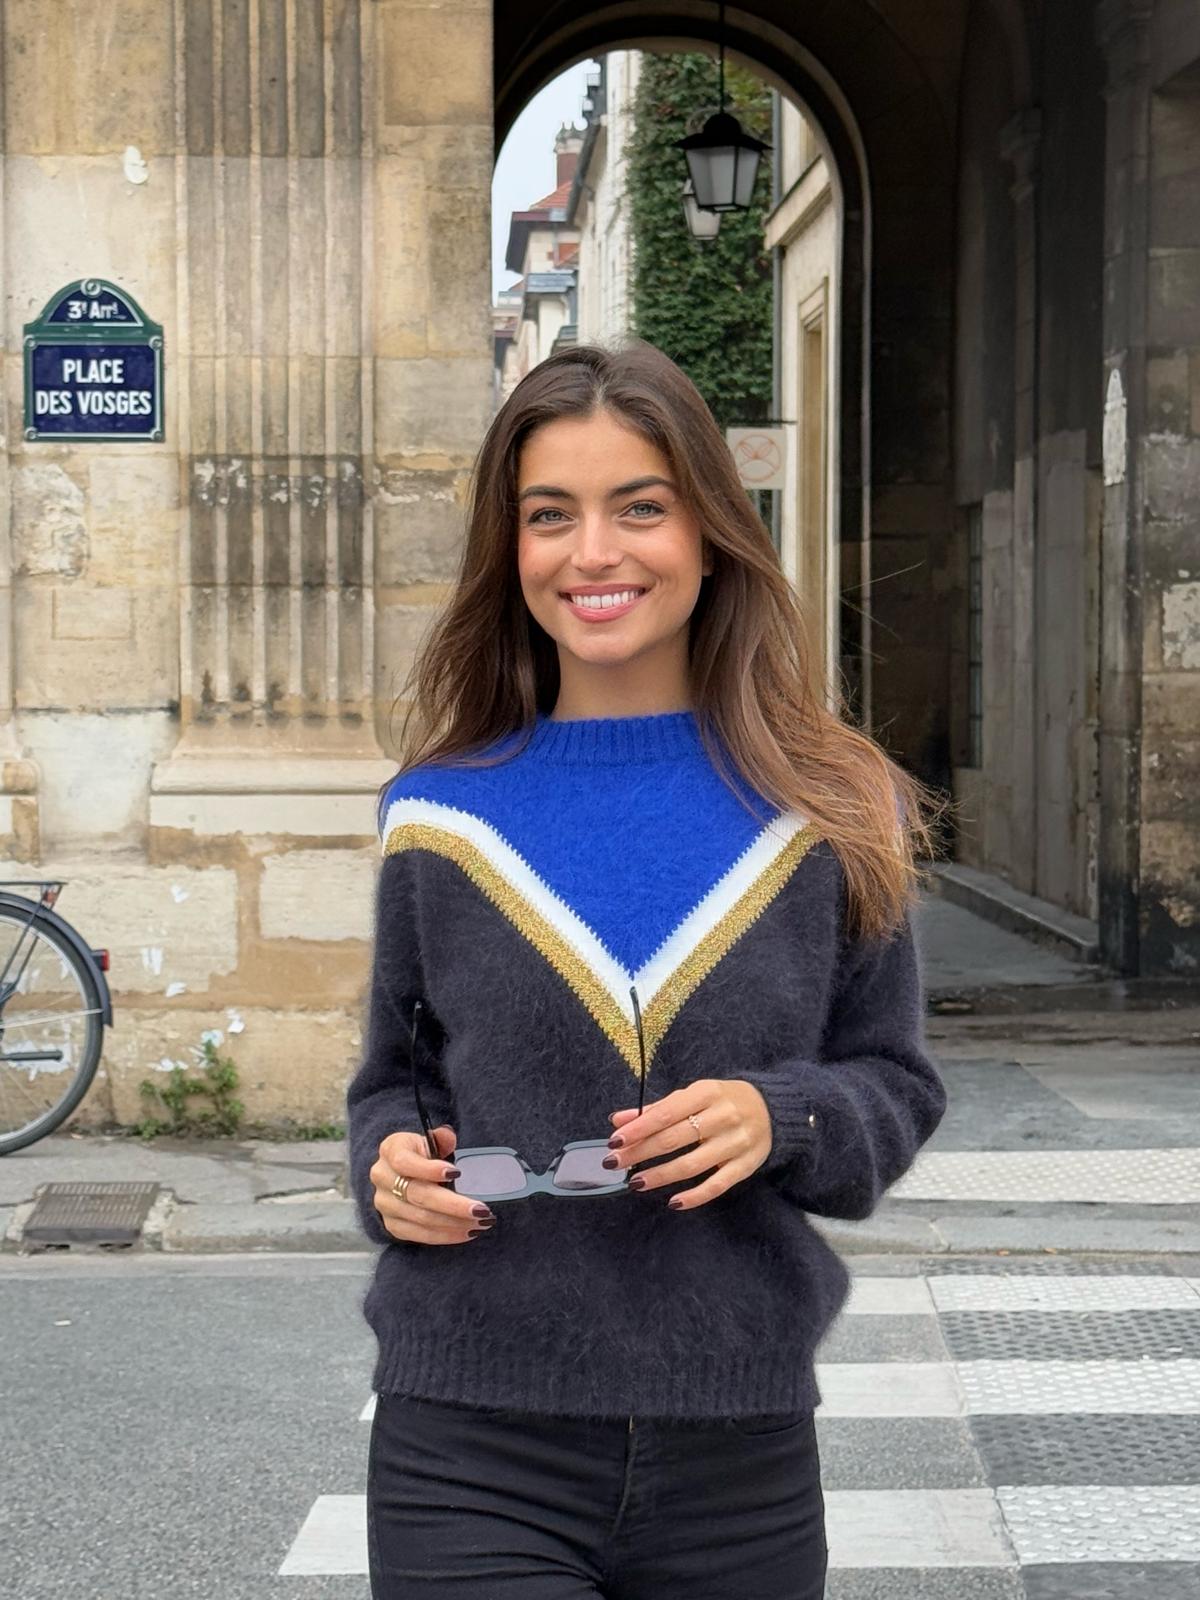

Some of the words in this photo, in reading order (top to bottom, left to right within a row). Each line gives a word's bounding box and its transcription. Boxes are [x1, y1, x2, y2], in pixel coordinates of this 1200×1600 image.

[62, 359, 124, 383] PLACE
[35, 391, 73, 415] DES
[76, 391, 152, 415] VOSGES
